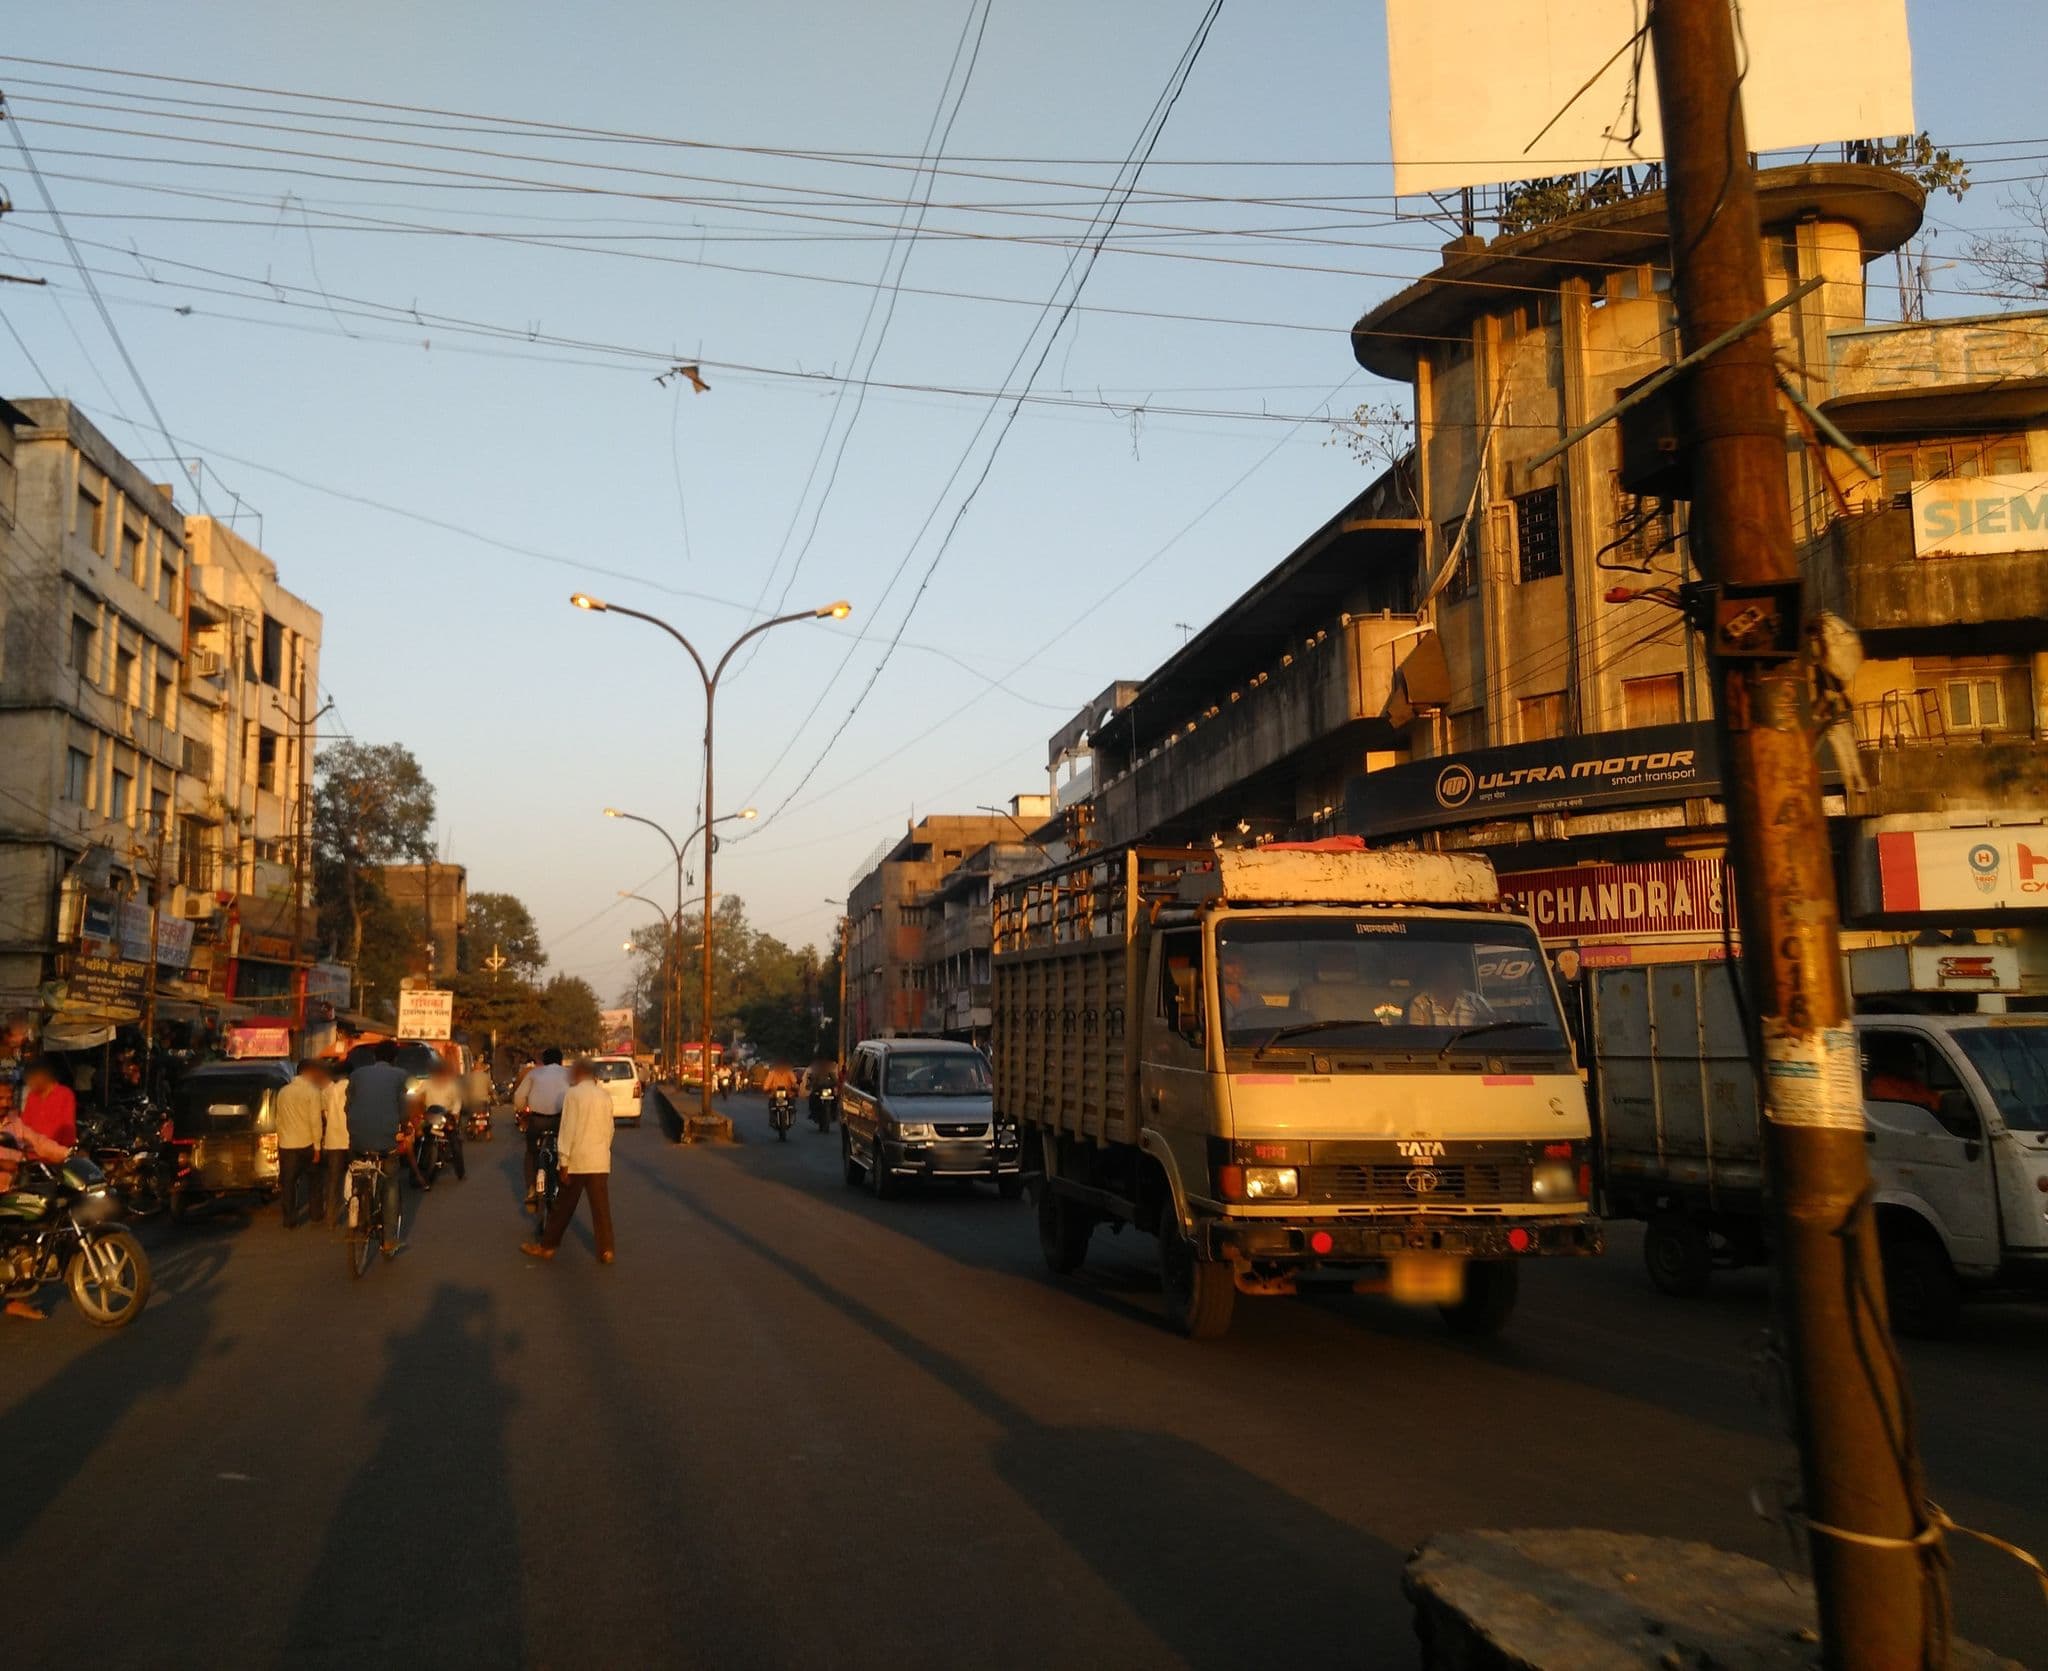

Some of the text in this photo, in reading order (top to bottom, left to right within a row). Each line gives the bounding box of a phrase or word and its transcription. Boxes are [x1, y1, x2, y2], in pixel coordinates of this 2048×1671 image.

[1923, 493, 2048, 537] SIEM
[1477, 750, 1695, 790] ULTRA MOTOR
[1611, 768, 1696, 786] smart transport
[2020, 881, 2048, 893] CY
[1396, 1141, 1446, 1156] TATA
